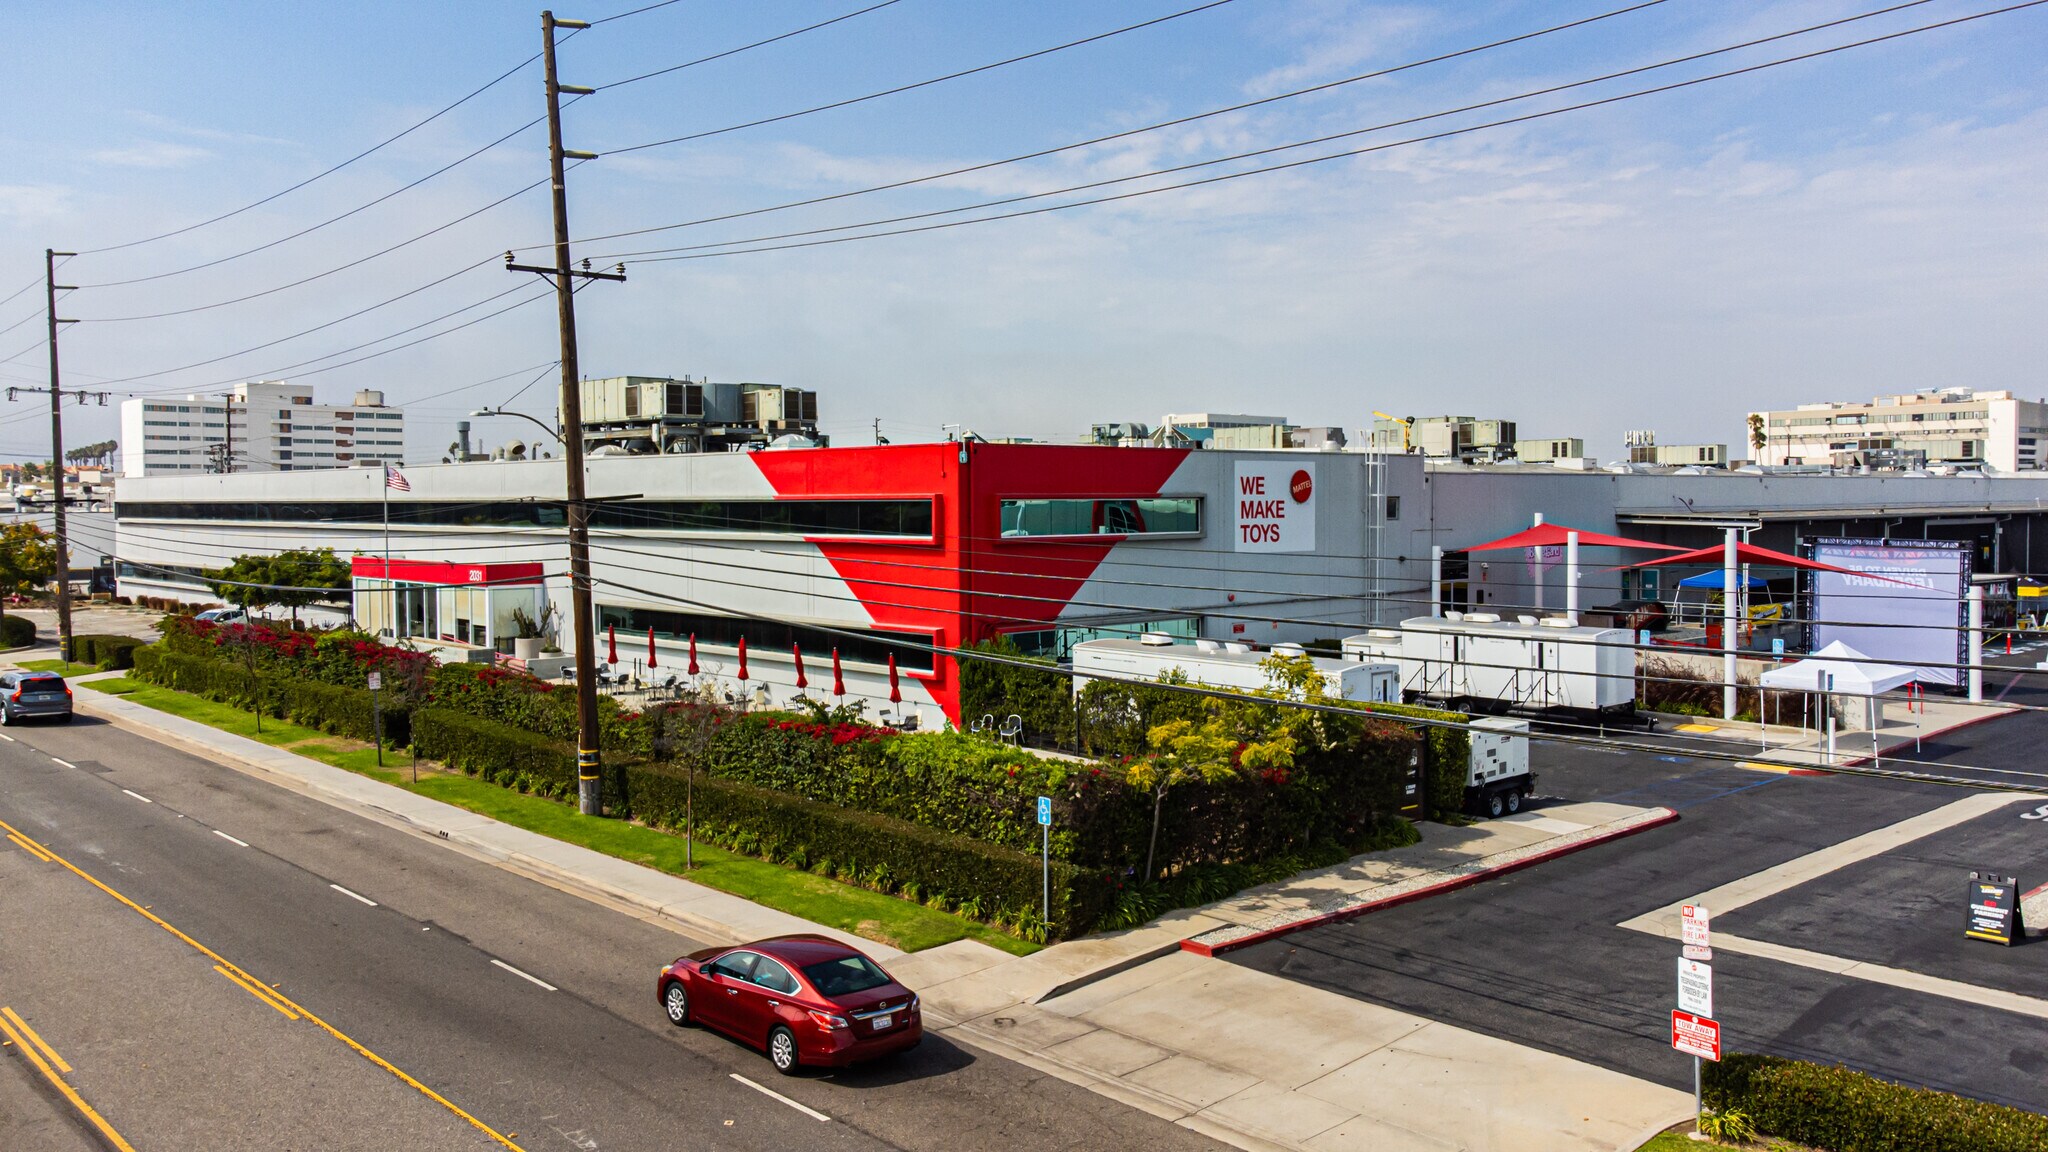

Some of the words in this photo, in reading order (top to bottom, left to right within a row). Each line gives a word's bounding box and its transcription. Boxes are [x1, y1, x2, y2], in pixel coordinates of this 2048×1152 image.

[1240, 476, 1265, 495] WE
[1292, 480, 1312, 494] MATTEL
[1240, 500, 1285, 519] MAKE
[1240, 524, 1280, 543] TOYS
[469, 570, 482, 581] 2031
[1683, 907, 1693, 917] NO
[1974, 909, 2004, 919] PARKING
[1683, 918, 1707, 928] PARKING
[1695, 932, 1708, 941] LANE
[1678, 1020, 1692, 1030] TOW
[1695, 1025, 1714, 1035] AWAY
